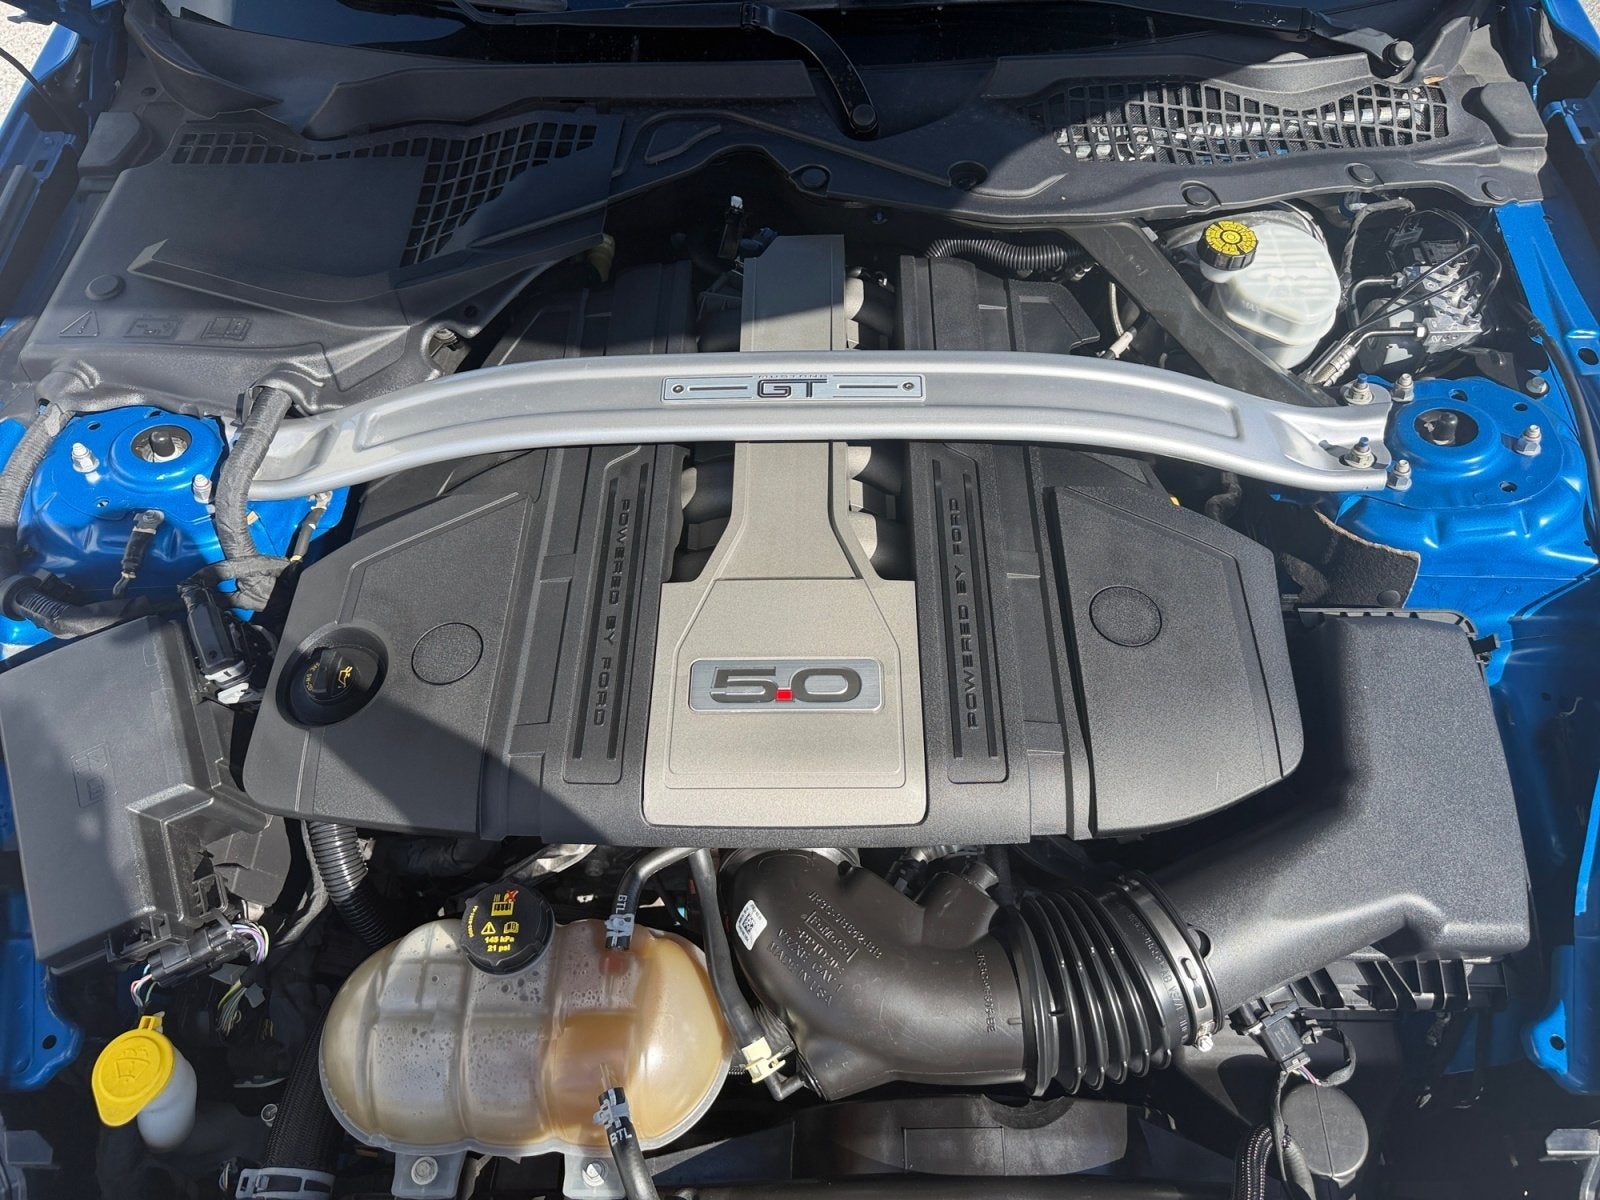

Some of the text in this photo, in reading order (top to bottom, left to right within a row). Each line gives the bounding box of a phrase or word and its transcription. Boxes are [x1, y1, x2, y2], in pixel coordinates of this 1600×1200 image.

[757, 379, 828, 398] GT
[954, 565, 967, 595] BY
[594, 499, 630, 726] POWERED BY FORD
[958, 605, 978, 729] POWERED
[709, 666, 862, 703] 5.0
[615, 894, 628, 914] BTL
[487, 944, 511, 952] 21 psi
[610, 1128, 632, 1146] BTL
